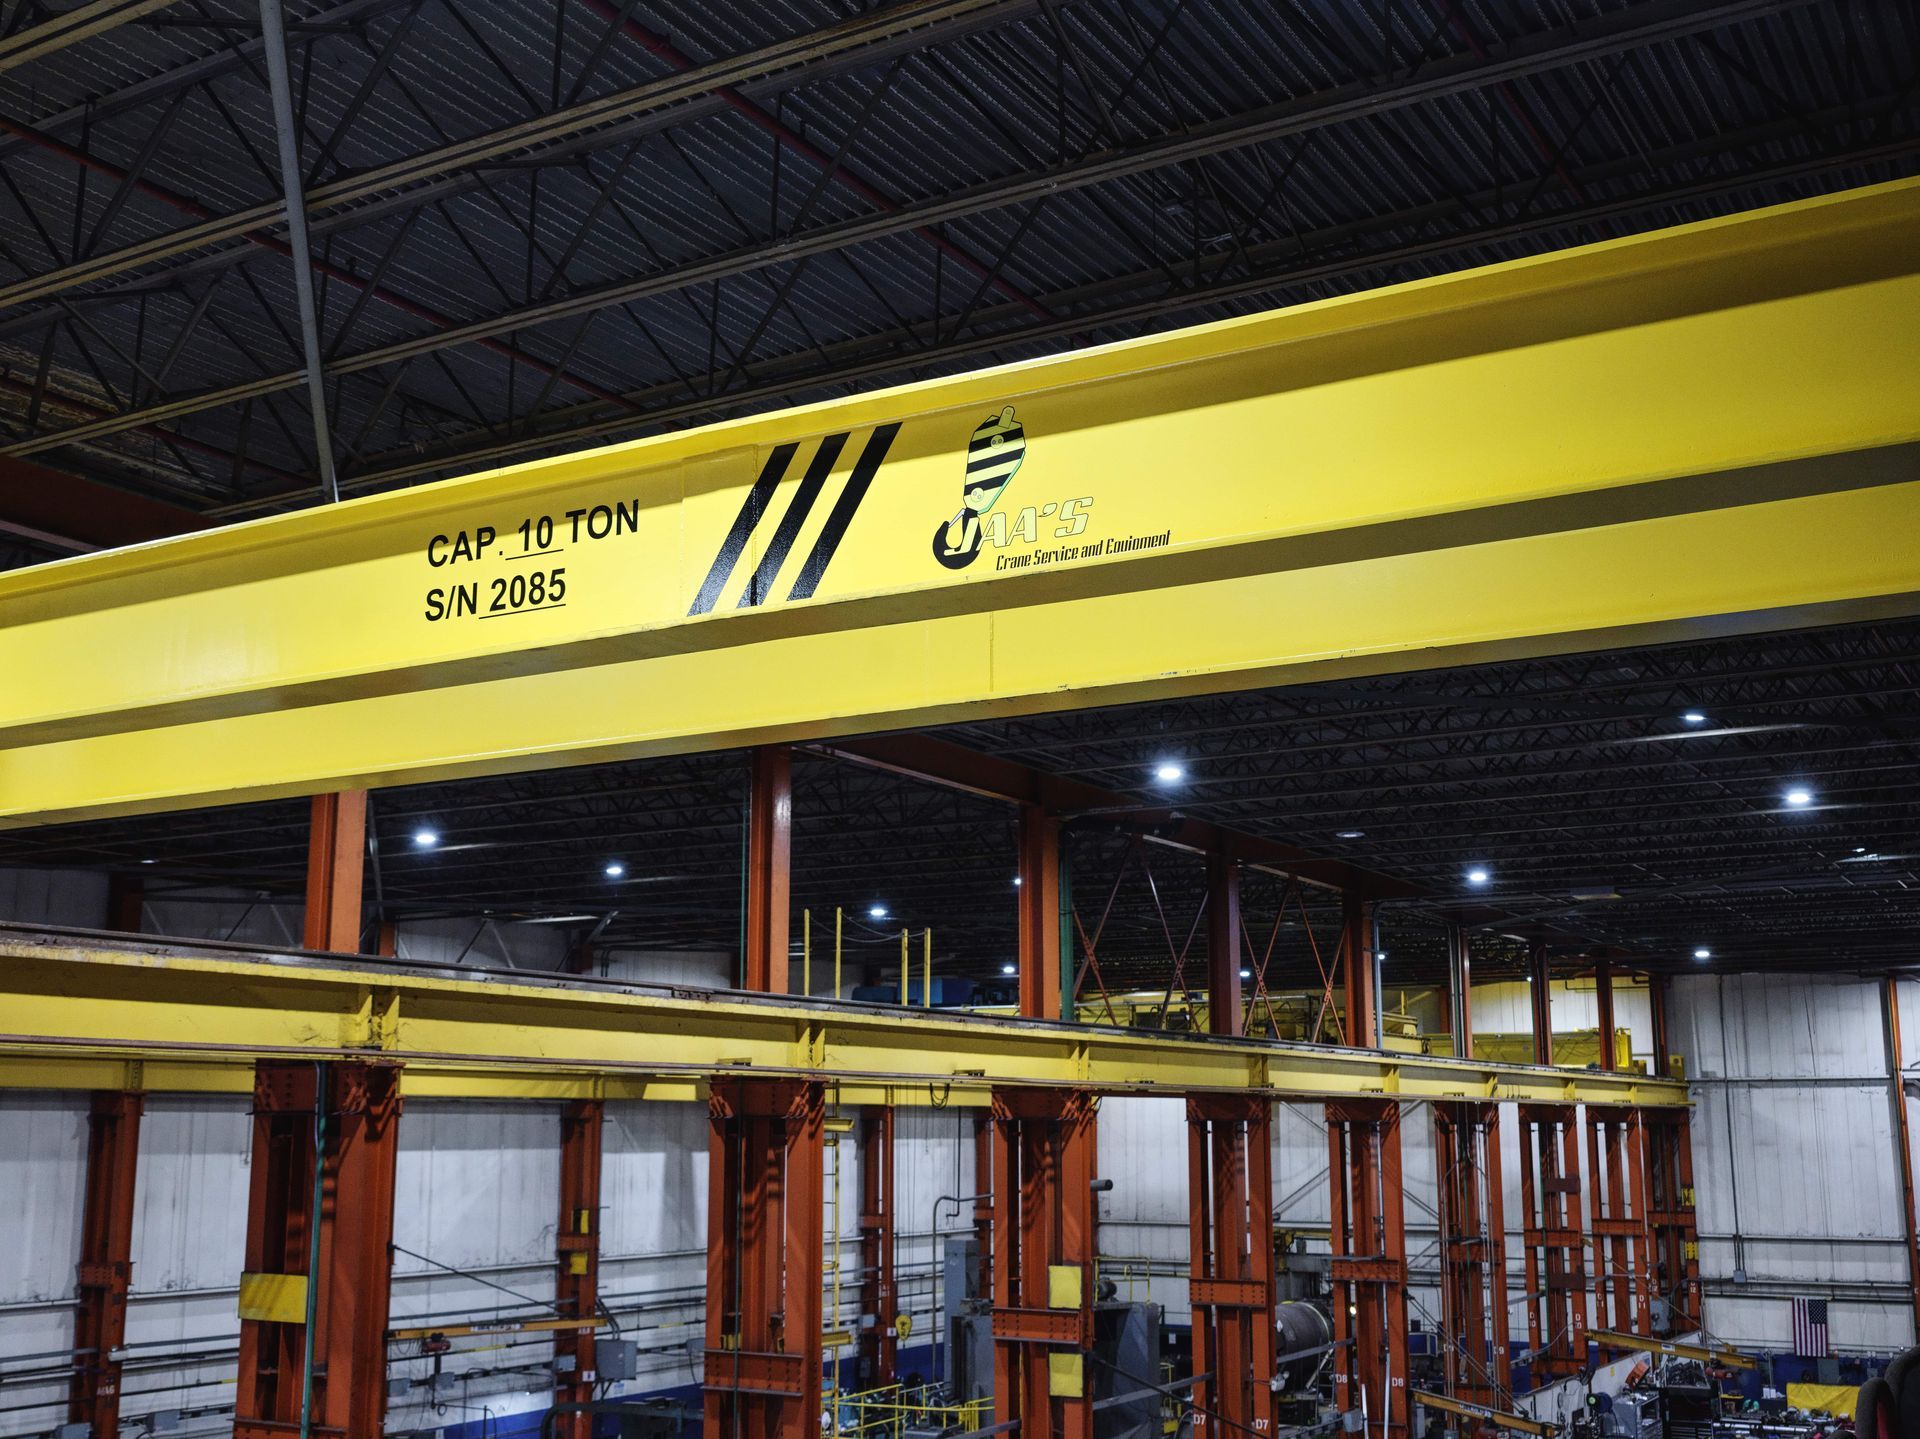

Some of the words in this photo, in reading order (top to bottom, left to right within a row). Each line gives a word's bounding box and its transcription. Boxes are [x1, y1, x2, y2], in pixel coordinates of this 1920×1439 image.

[427, 526, 503, 567] CAP.
[518, 515, 554, 552] 10
[565, 498, 639, 543] TON
[995, 554, 1032, 571] Crane
[1033, 545, 1079, 565] Service
[1080, 539, 1104, 558] and
[425, 582, 479, 622] S/N
[489, 568, 567, 612] 2085
[1391, 1376, 1404, 1387] D8
[1193, 1413, 1206, 1425] D7
[1255, 1418, 1269, 1431] D7
